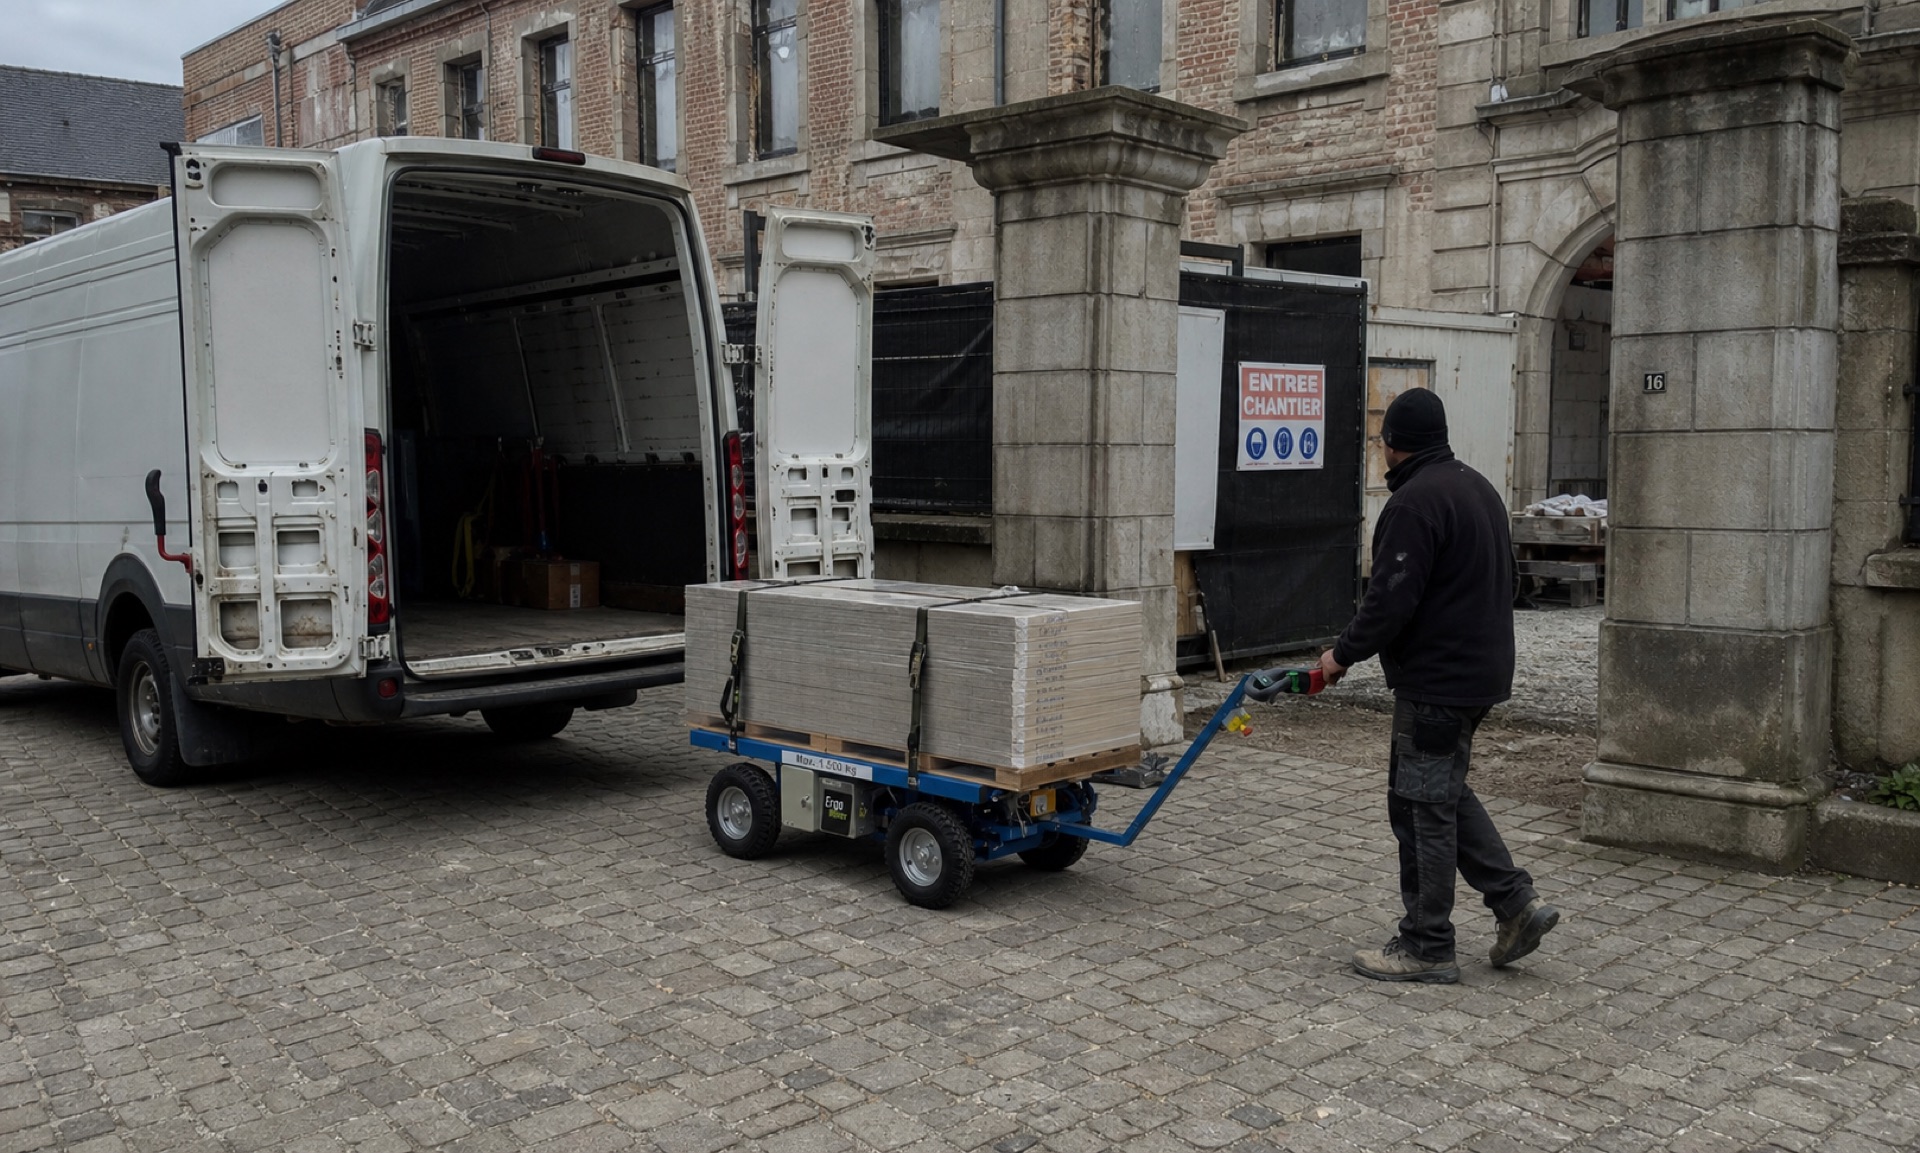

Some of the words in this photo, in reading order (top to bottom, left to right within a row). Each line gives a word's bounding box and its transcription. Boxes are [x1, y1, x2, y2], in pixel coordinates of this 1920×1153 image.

[1249, 373, 1318, 393] ENTREE
[1646, 375, 1663, 390] 16
[1244, 396, 1321, 416] CHANTIER
